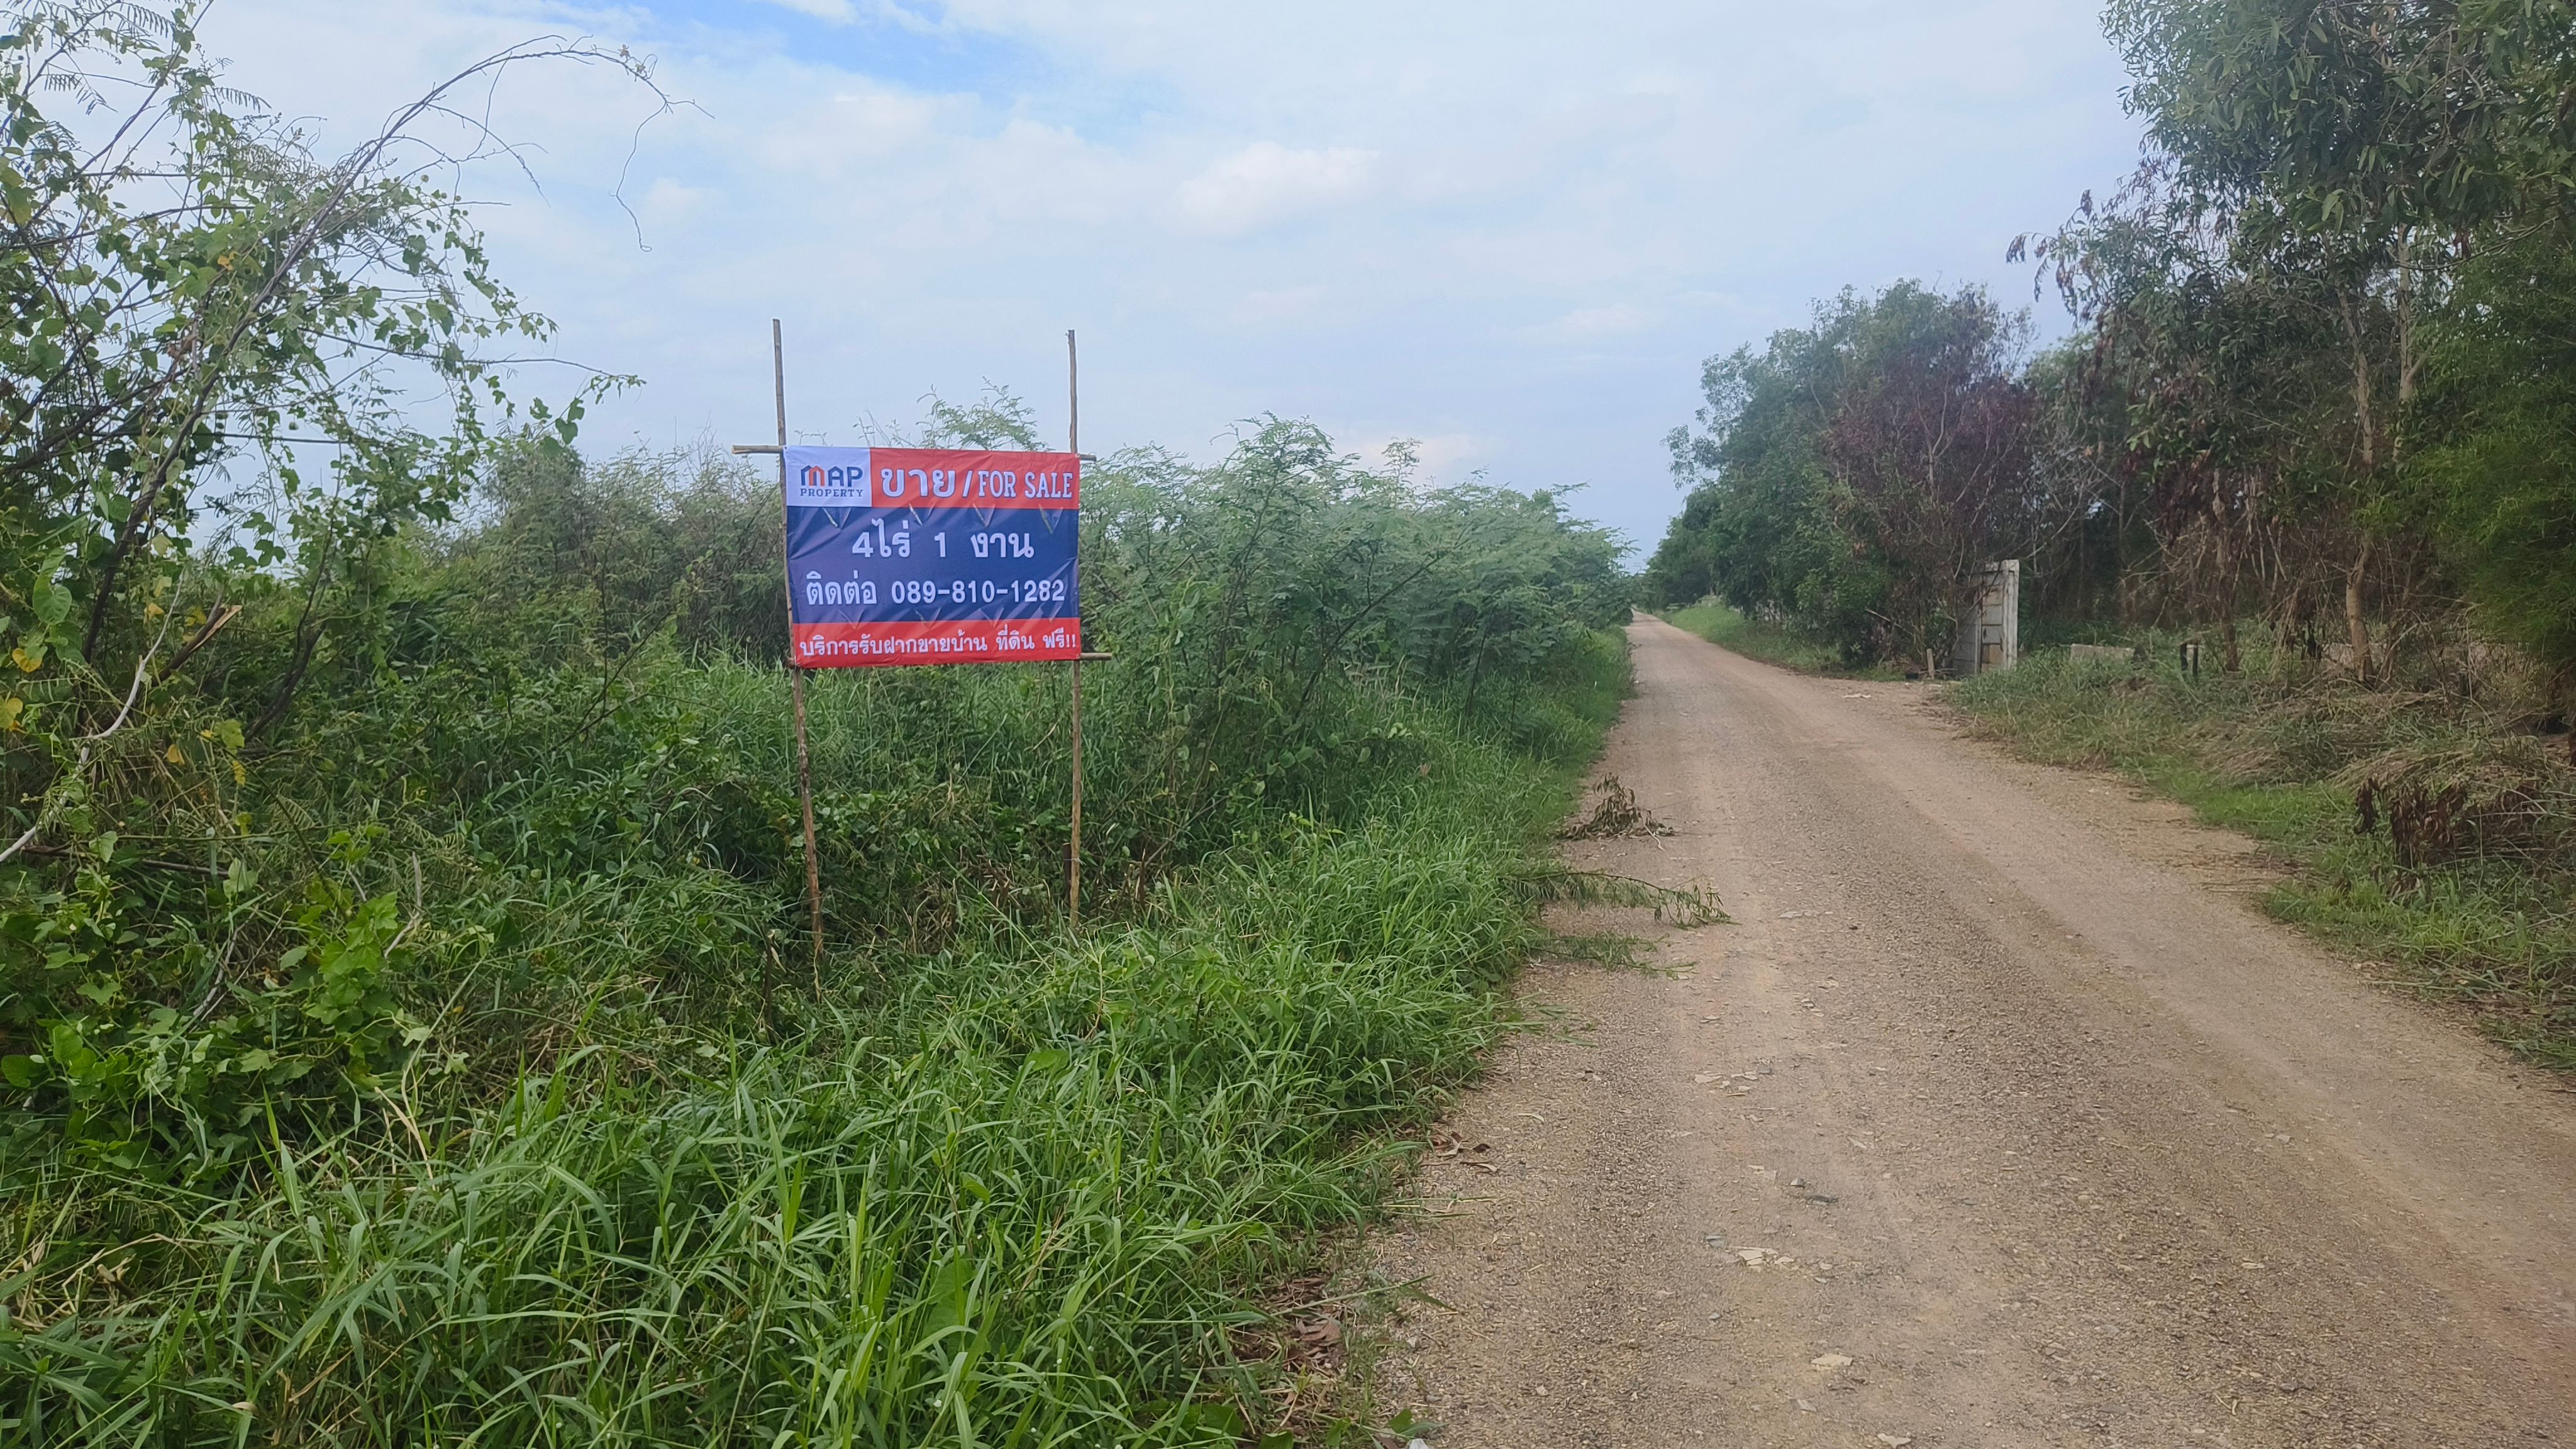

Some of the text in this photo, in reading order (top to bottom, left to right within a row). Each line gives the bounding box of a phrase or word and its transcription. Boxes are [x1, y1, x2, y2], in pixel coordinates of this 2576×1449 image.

[801, 465, 863, 487] MAP
[881, 469, 955, 497] ขาย
[1024, 472, 1073, 499] SALE
[800, 488, 863, 497] PROPERTY
[934, 532, 946, 558] 1
[970, 532, 1035, 558] งาน
[806, 570, 1065, 605] ติดต่อ 089-810-1282
[799, 631, 988, 656] บริการรับฝากขายบ้าน
[996, 625, 1035, 650] ที่ดิน
